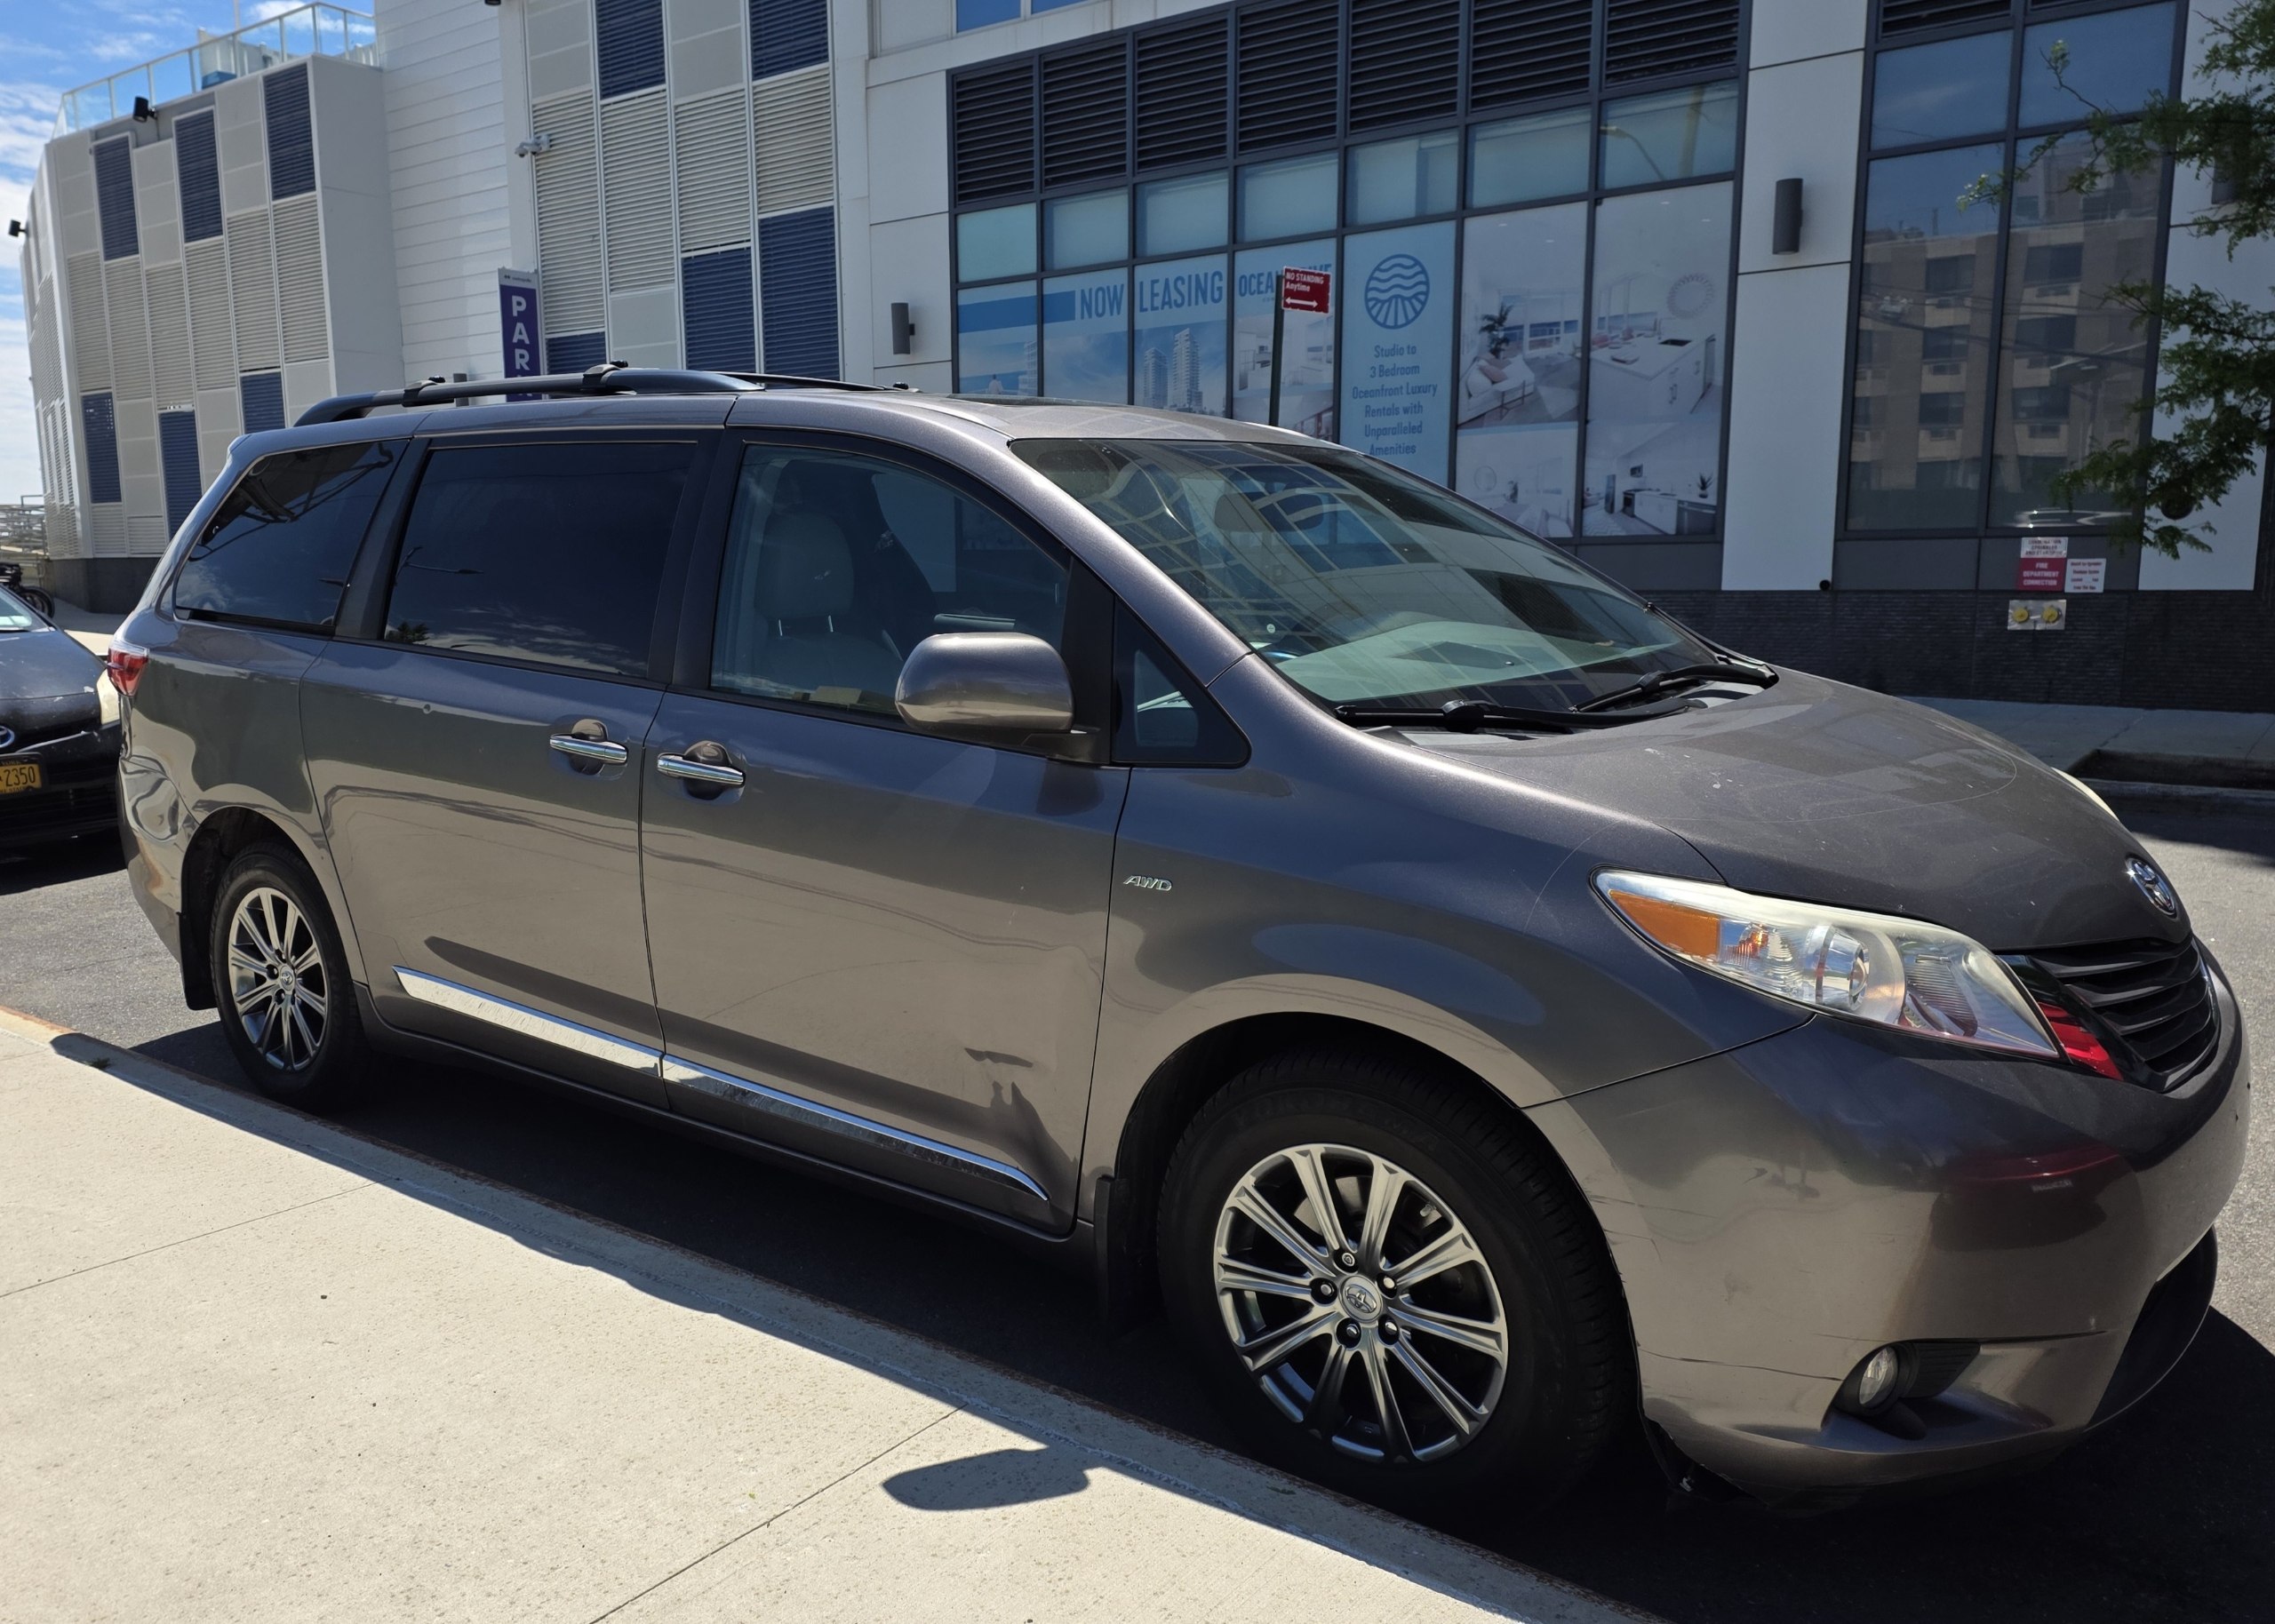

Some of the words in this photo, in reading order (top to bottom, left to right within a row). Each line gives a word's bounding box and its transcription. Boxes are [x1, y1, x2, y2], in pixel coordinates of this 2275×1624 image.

[1238, 270, 1281, 298] OCEA
[1285, 271, 1295, 281] NO
[1296, 273, 1325, 285] STANDING
[1286, 281, 1311, 292] Anytime
[1080, 283, 1125, 321] NOW
[1138, 270, 1224, 313] LEASING
[511, 295, 531, 377] PAR
[1374, 343, 1405, 358] Studio
[1407, 344, 1417, 355] to
[1369, 365, 1377, 378] 3
[1378, 363, 1420, 378] Bedroom
[1352, 384, 1404, 400] Oceanfront
[1406, 382, 1438, 397] Luxury
[1364, 402, 1401, 418] Rentals
[1402, 401, 1424, 415] with
[1364, 420, 1424, 441] Unparalleled
[1369, 442, 1417, 457] Amenities
[4, 766, 36, 787] 2350
[1122, 875, 1173, 892] AWD
